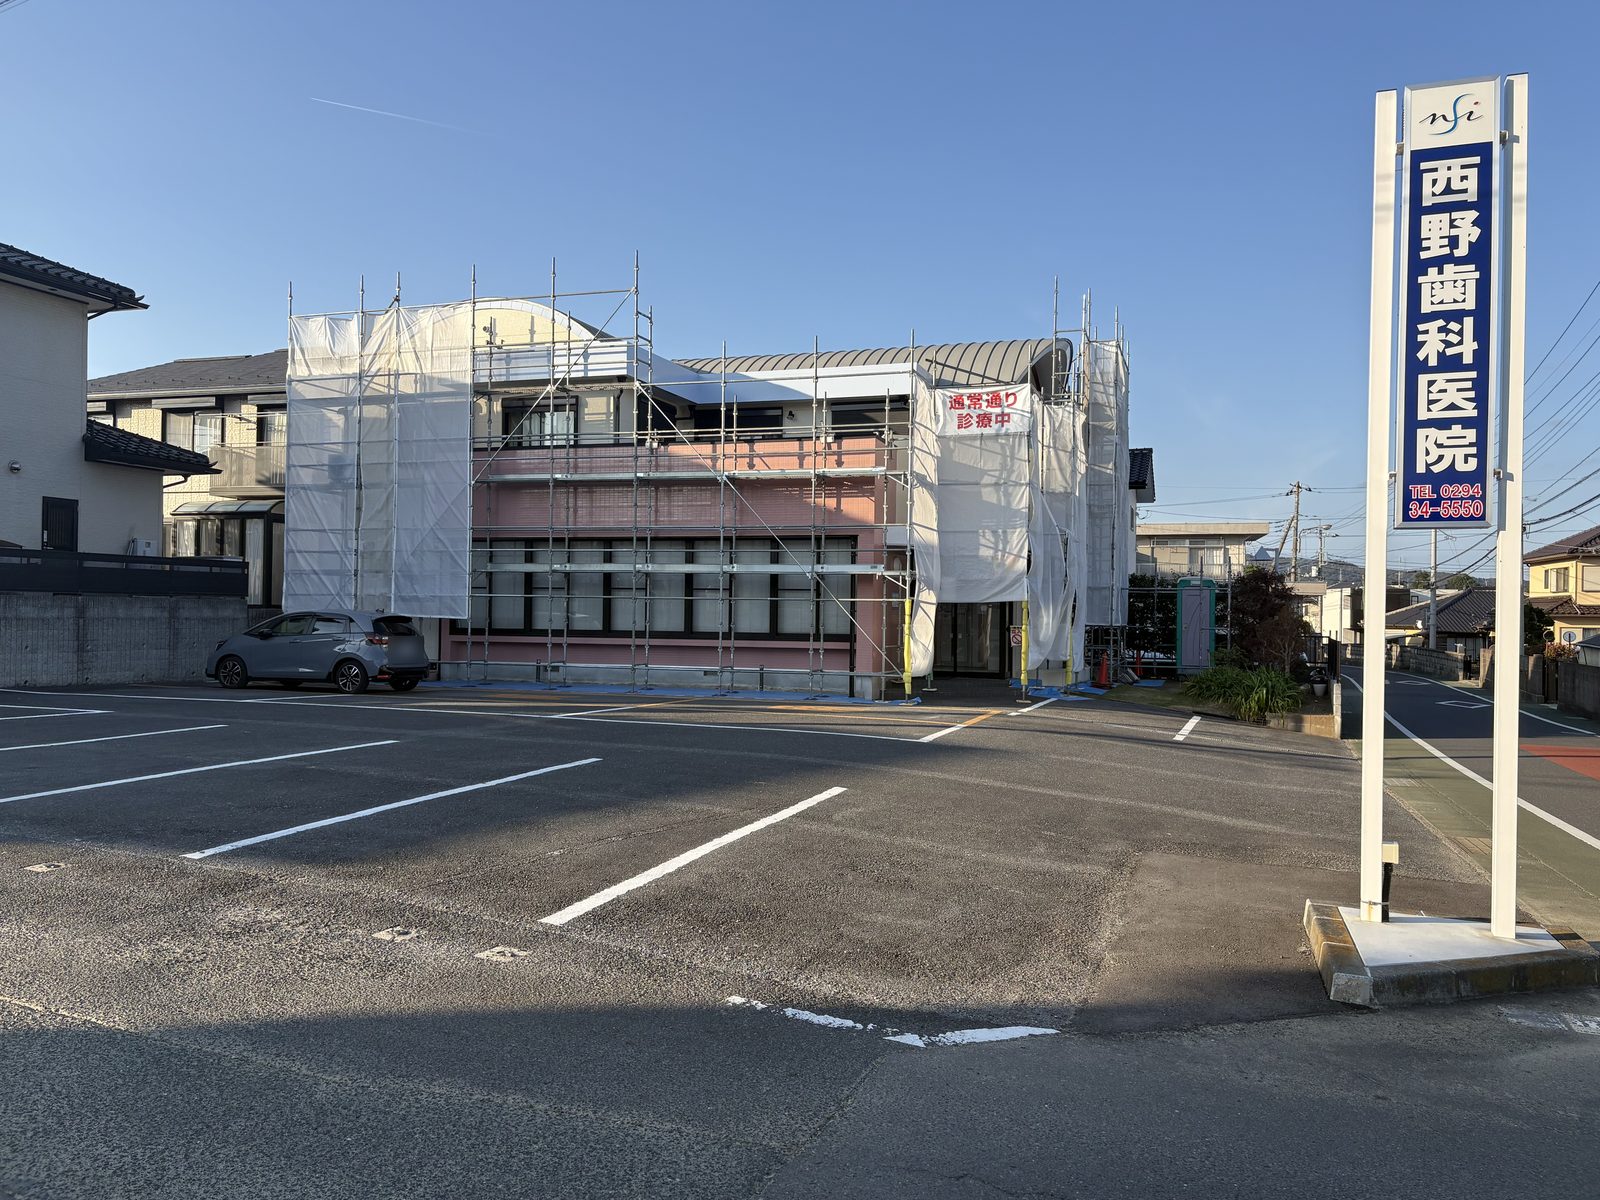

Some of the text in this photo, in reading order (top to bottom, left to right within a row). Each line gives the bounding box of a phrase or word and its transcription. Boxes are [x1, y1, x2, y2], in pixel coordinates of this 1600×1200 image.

[1416, 156, 1482, 474] 西野歯科医院
[949, 391, 1017, 410] 通常通り
[957, 411, 1011, 429] 診療中
[1409, 483, 1482, 499] TEL 0294
[1409, 500, 1483, 518] 34-5550
